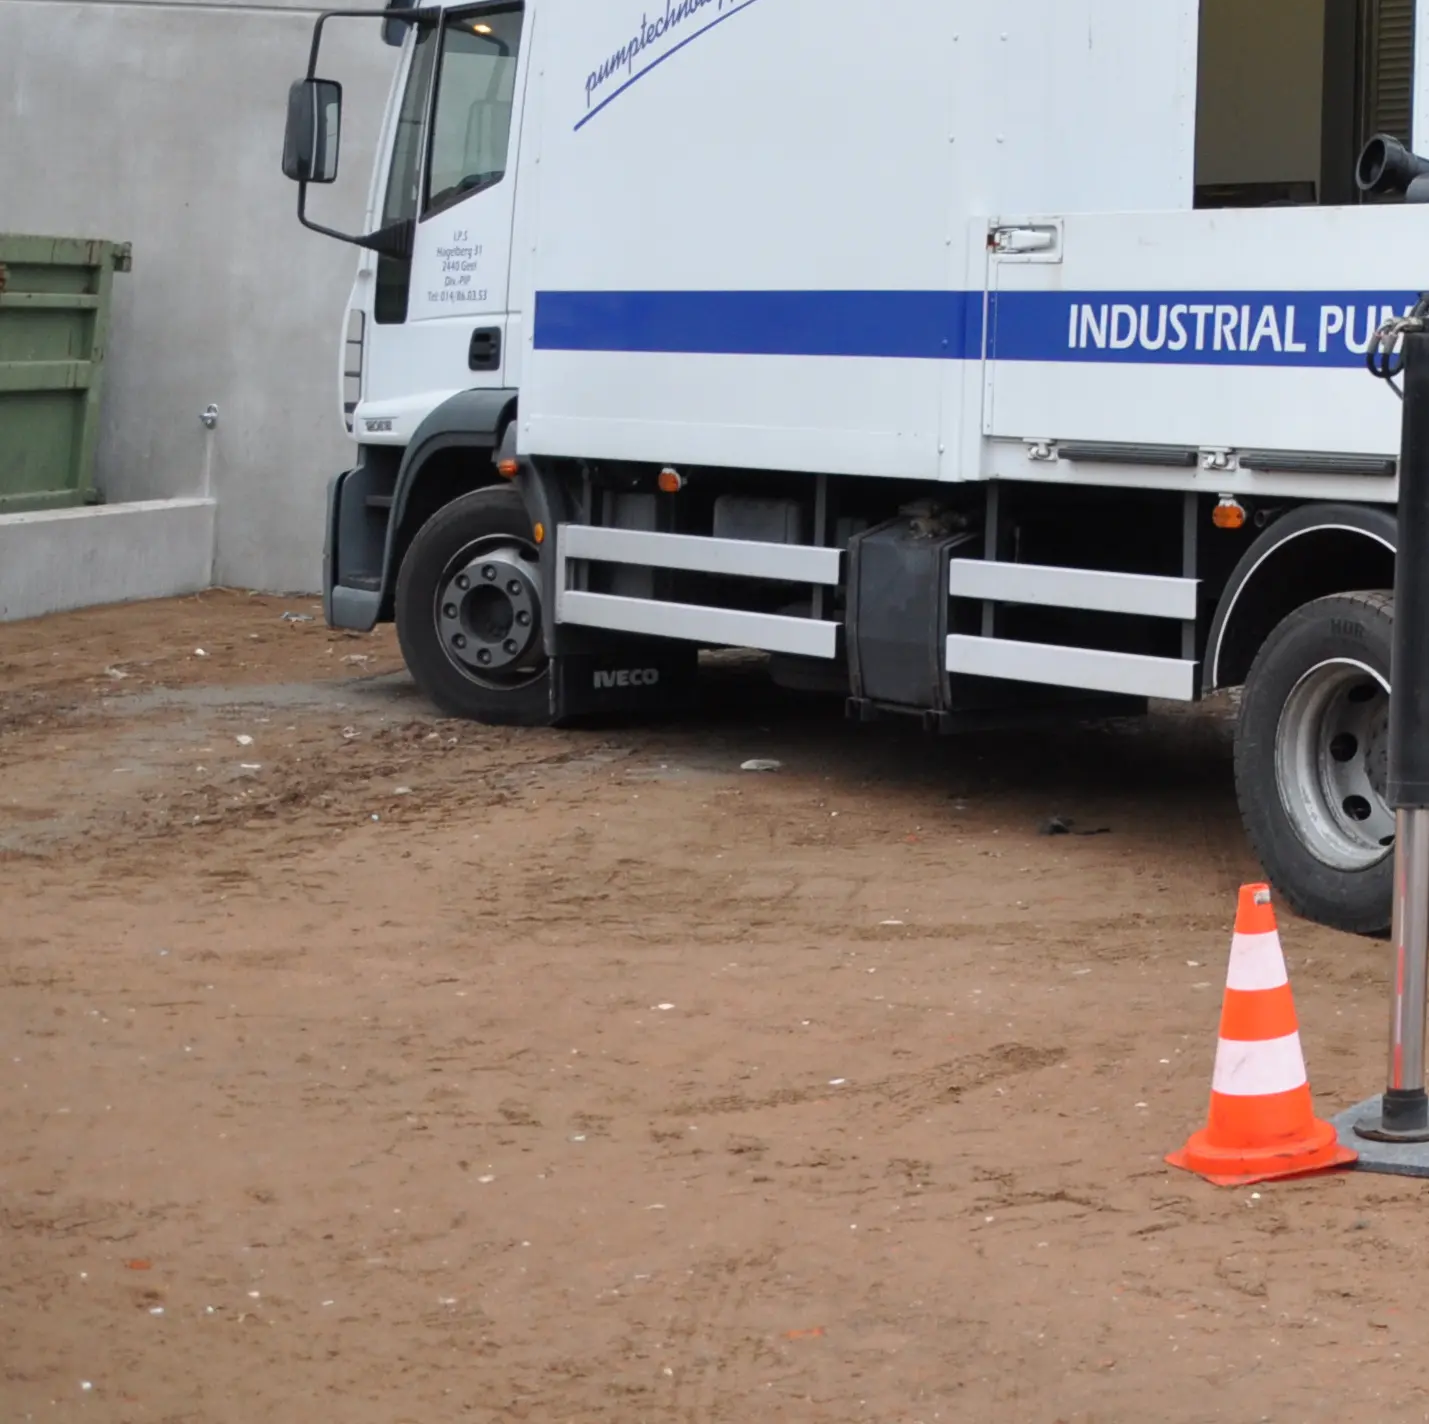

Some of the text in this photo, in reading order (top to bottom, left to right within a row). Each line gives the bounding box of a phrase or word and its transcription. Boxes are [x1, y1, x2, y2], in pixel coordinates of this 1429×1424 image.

[1068, 303, 1307, 353] INDUSTRIAL
[1318, 305, 1413, 354] PUM
[593, 668, 660, 689] IVECO
